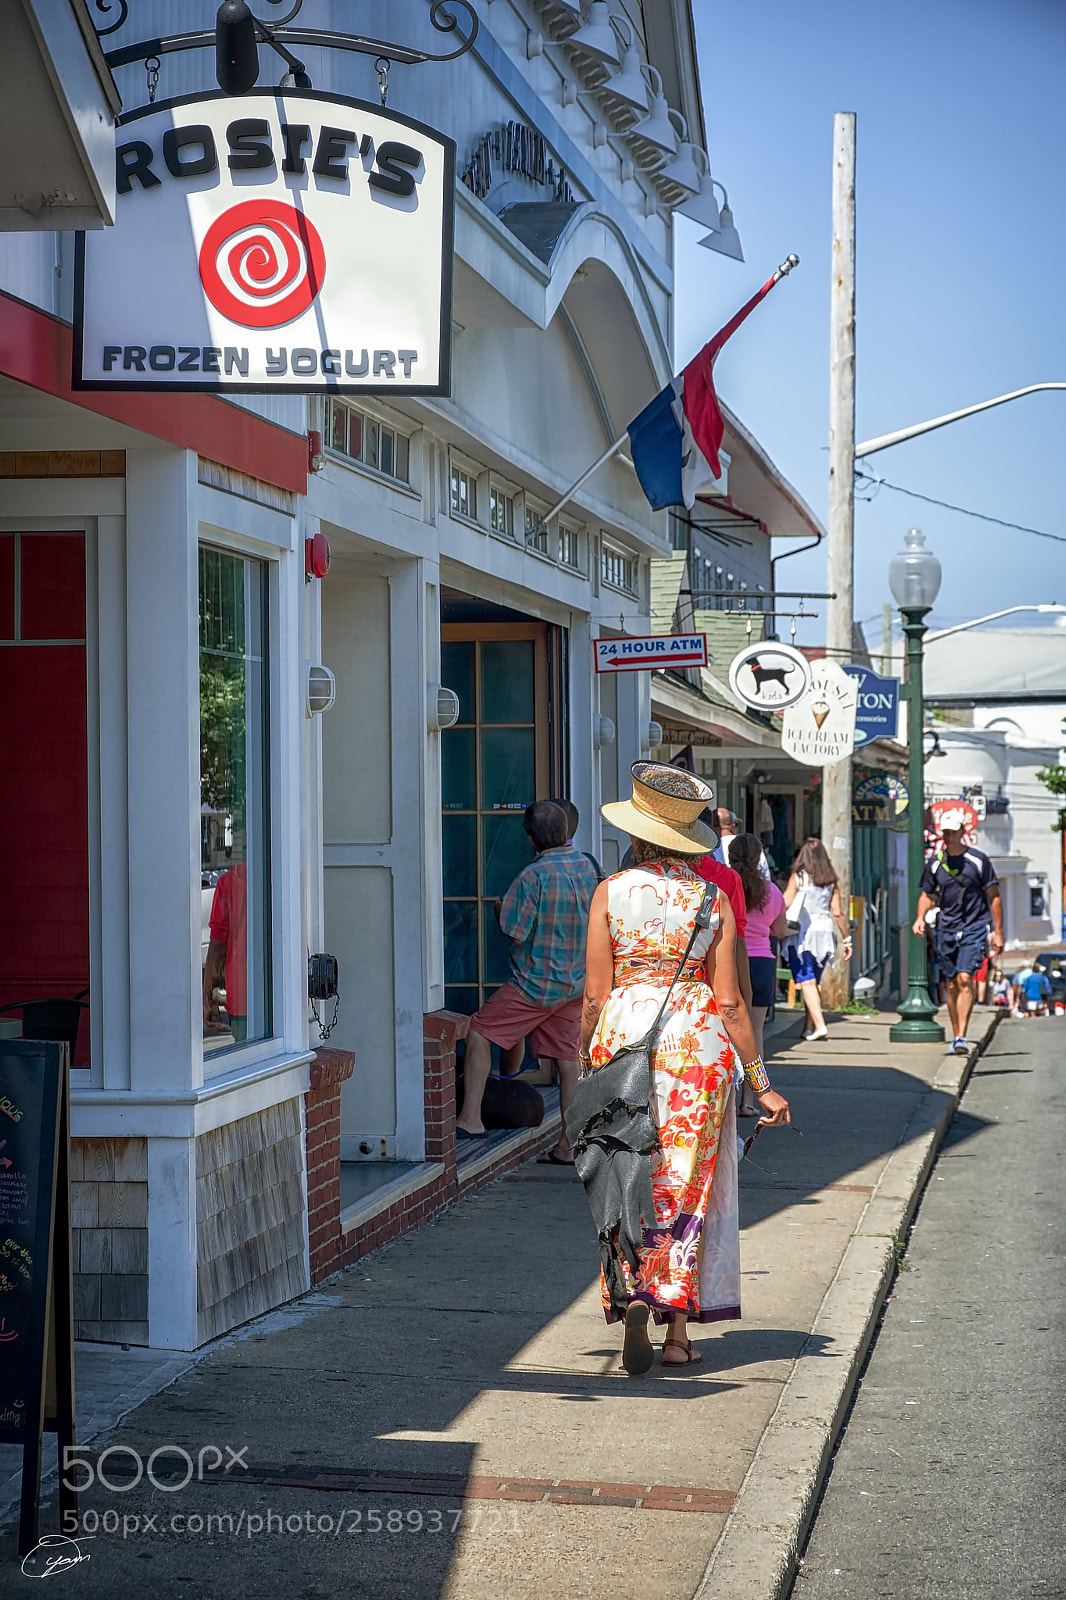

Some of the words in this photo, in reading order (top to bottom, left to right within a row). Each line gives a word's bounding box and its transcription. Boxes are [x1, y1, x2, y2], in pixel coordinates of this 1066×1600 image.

[116, 118, 424, 196] ROSIE'S
[103, 346, 250, 377] FROZEN
[265, 347, 418, 379] YOGURT
[599, 644, 618, 656] 24
[622, 641, 666, 654] HOUR
[670, 638, 702, 651] ATM
[787, 728, 804, 741] ICE
[808, 730, 849, 744] CREAM
[793, 742, 841, 756] FACTORY
[852, 805, 891, 821] ATM
